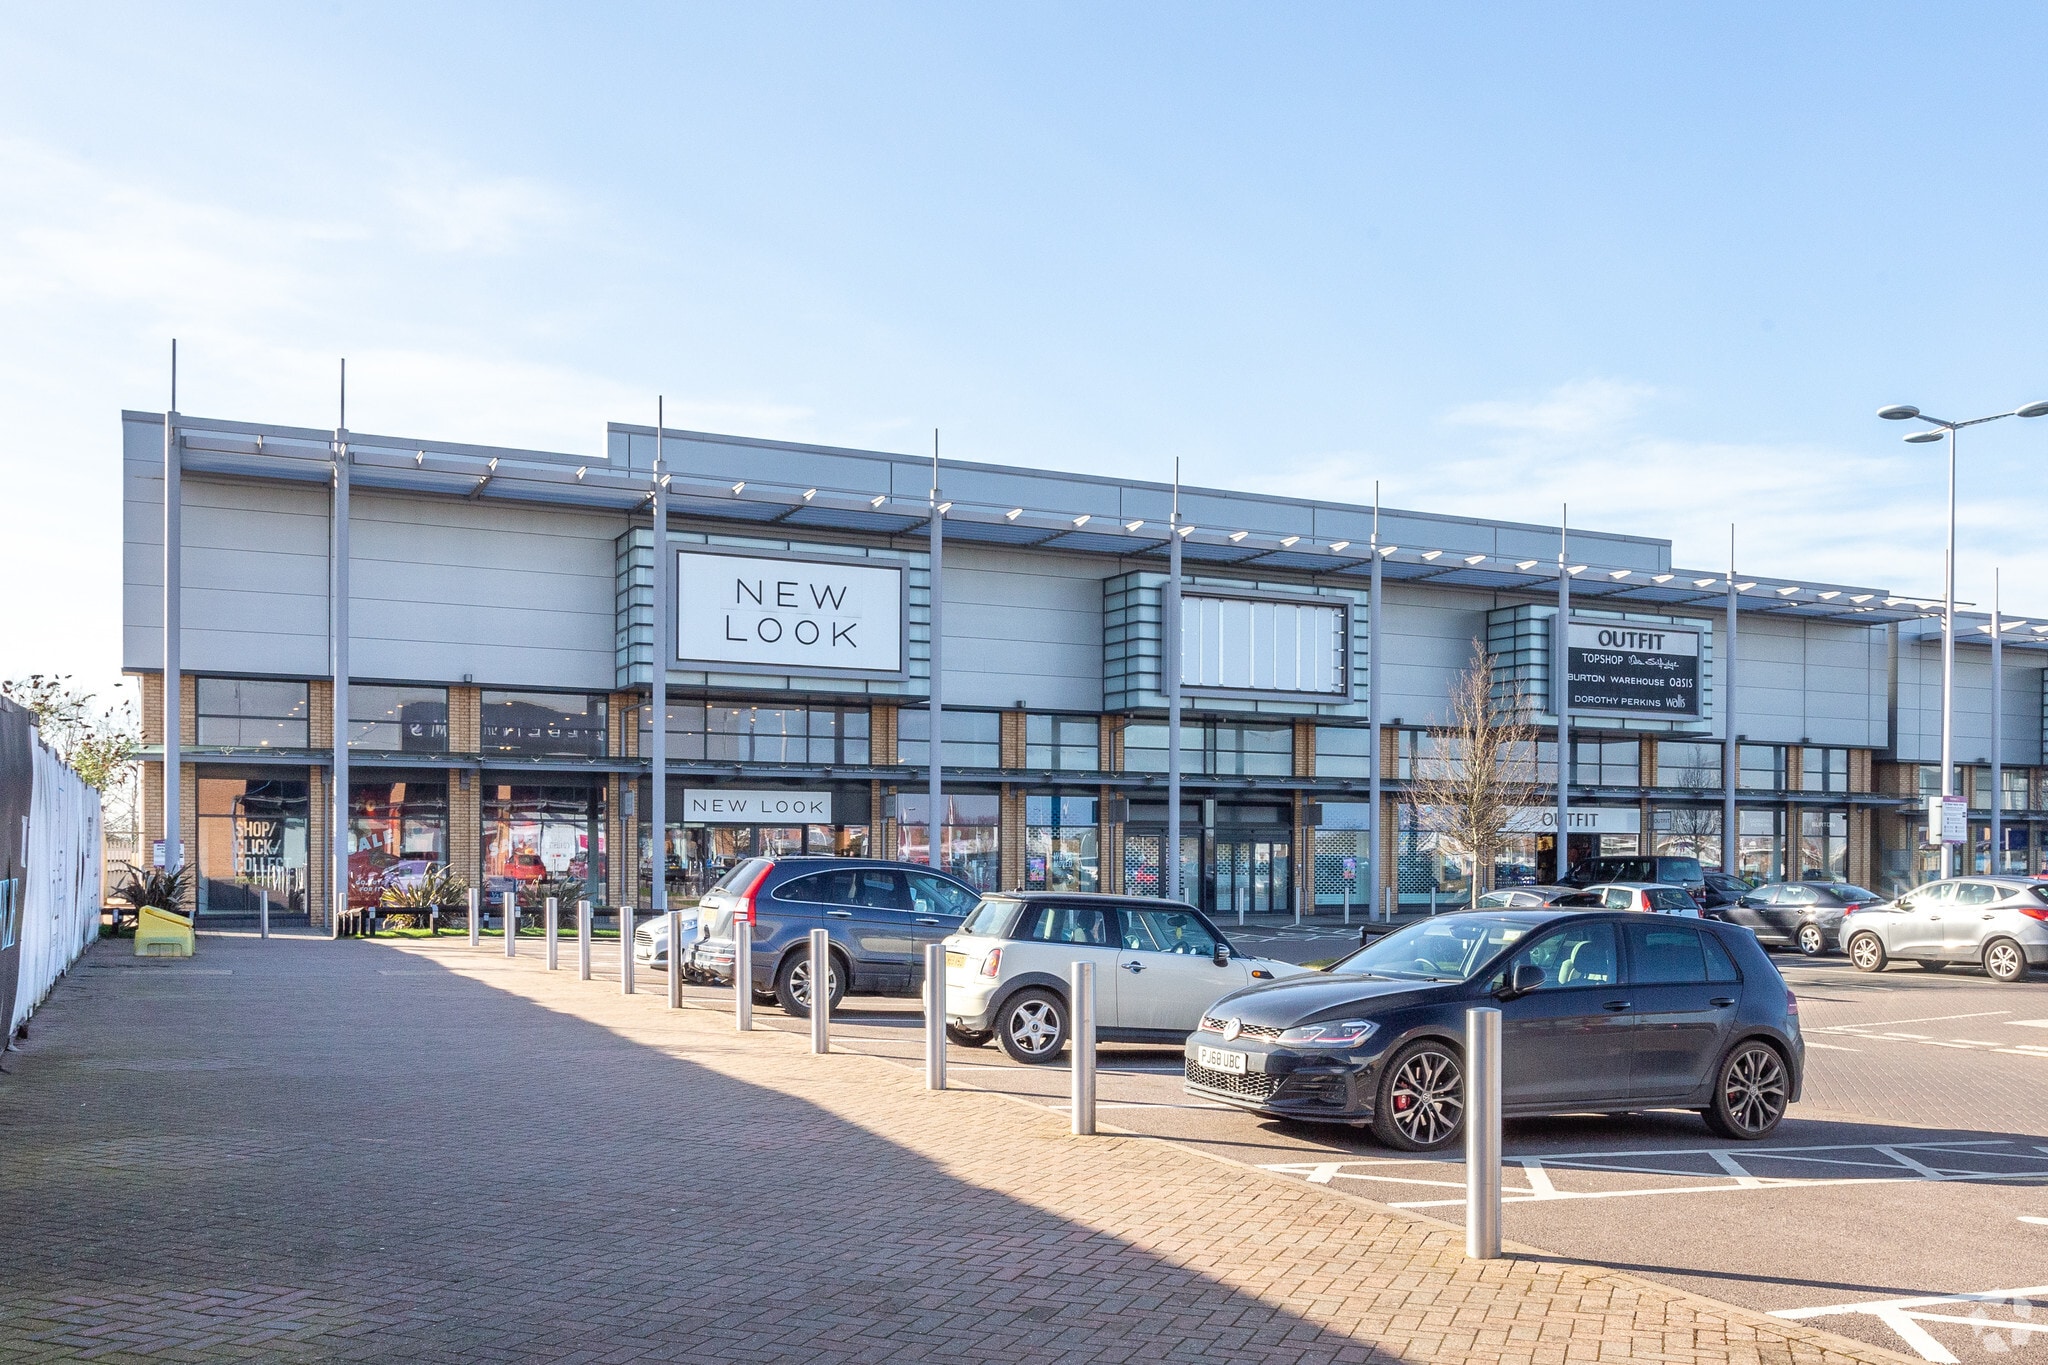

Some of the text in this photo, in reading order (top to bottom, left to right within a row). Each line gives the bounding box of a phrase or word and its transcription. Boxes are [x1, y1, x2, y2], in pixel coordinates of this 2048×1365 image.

[737, 578, 847, 610] NEW
[726, 615, 857, 648] LOOK
[1598, 630, 1666, 650] OUTFIT
[1582, 653, 1624, 665] TOPSHOP
[1568, 673, 1605, 683] BURTON
[1610, 676, 1665, 686] WAREHOUSE
[1574, 695, 1618, 705] DOROTHY
[1621, 697, 1661, 707] PERKINS
[693, 799, 823, 813] NEW LOOK
[235, 821, 277, 837] SHOP/
[235, 857, 292, 873] COLLECT
[1201, 1049, 1241, 1069] PJ68 UBC
